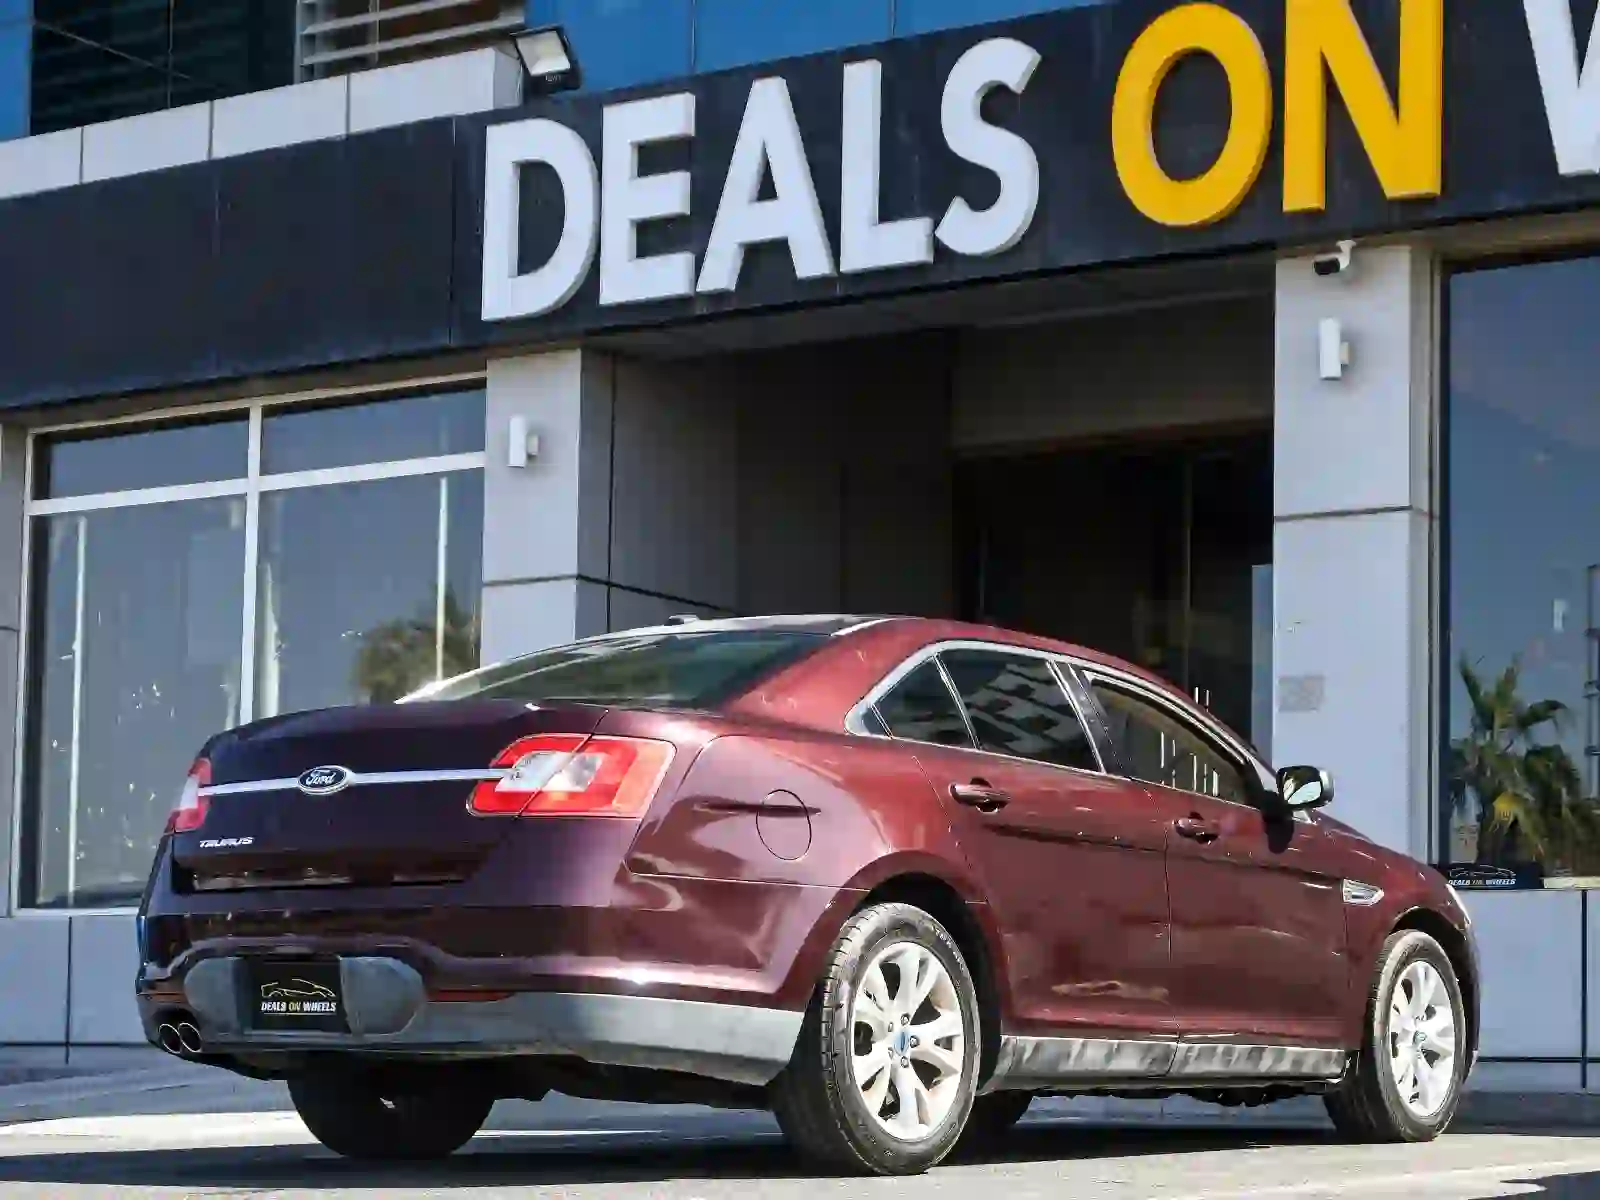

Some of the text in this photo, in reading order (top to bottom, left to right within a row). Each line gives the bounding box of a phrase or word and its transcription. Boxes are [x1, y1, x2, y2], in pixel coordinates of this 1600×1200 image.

[481, 37, 1042, 322] DEALS
[1112, 0, 1445, 227] ON
[306, 769, 337, 786] Ford
[199, 836, 255, 848] TAURUS
[261, 1001, 337, 1012] DEALS ON WHEELS
